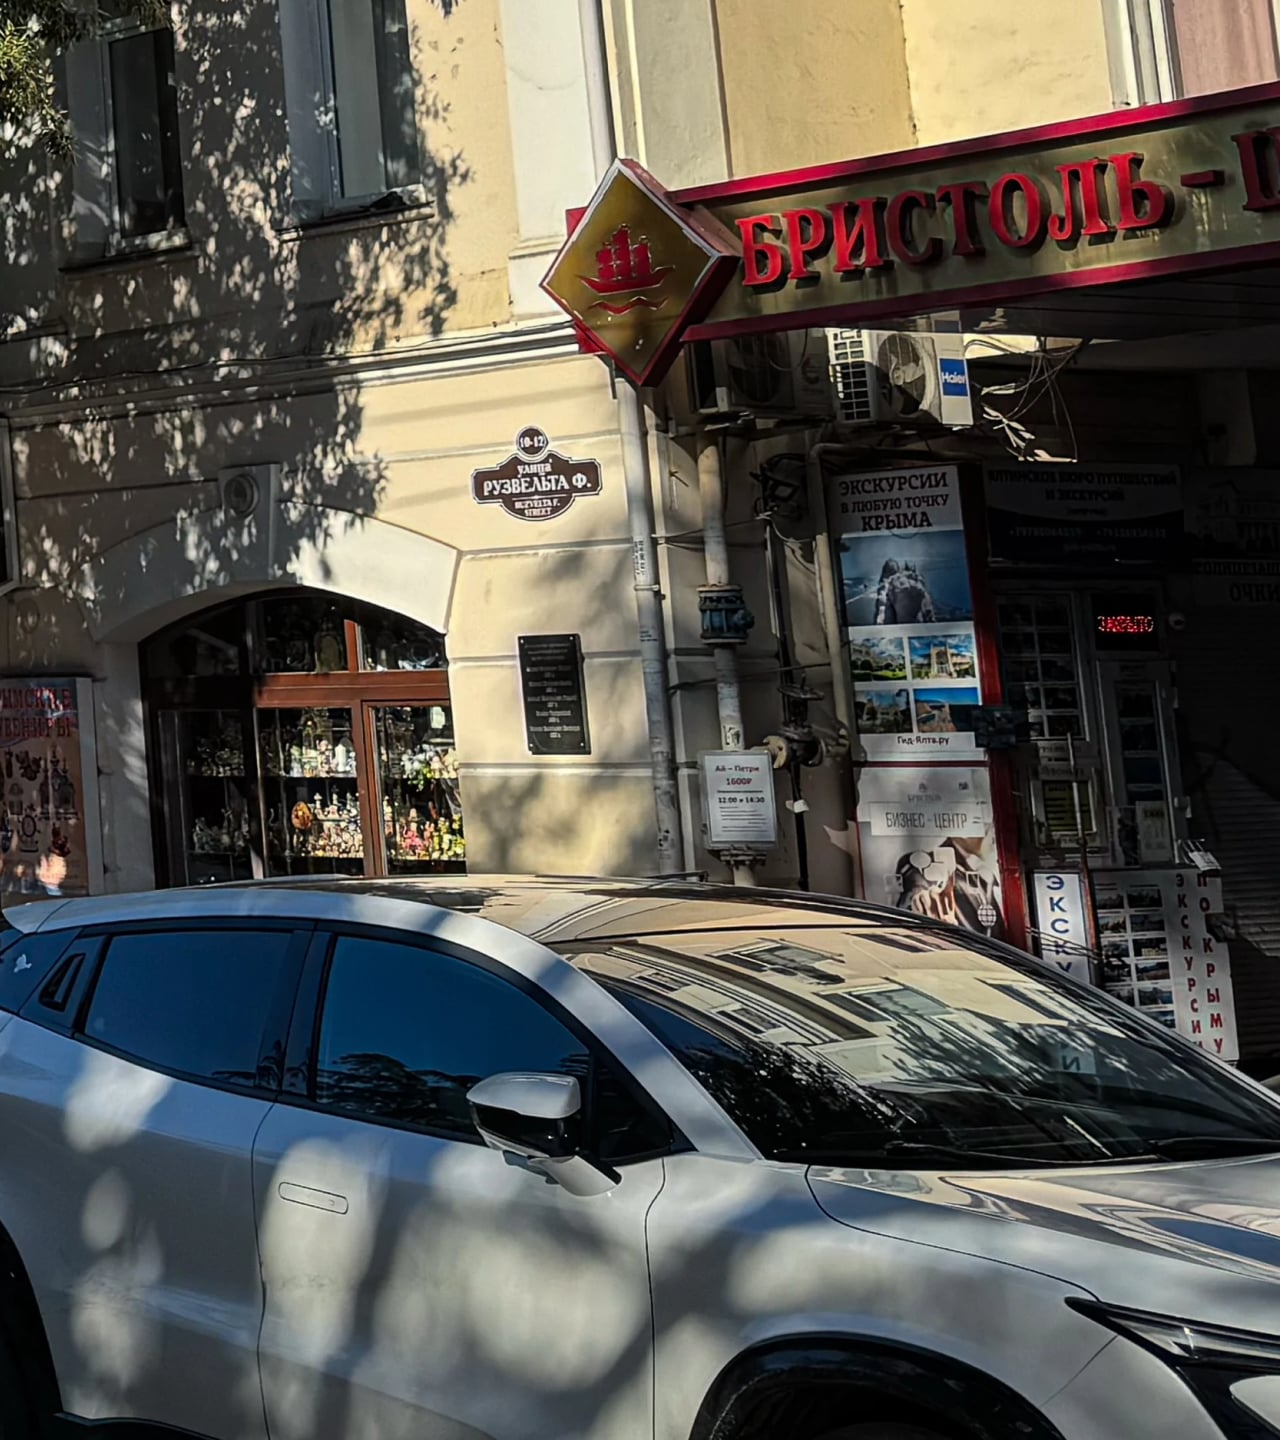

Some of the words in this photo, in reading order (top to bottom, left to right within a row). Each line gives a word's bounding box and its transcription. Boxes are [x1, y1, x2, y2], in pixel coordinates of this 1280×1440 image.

[942, 371, 966, 385] Haier
[483, 474, 569, 496] РУЗВЕЛЬТА
[571, 472, 592, 489] Ф.
[840, 471, 948, 496] ЭКСКУРСИИ
[852, 498, 902, 512] ЛЮБУЮ
[905, 494, 949, 508] ТОЧКУ
[861, 511, 932, 531] КРЫМА
[885, 811, 926, 829] БИЗНЕС
[933, 812, 968, 830] ЦЕНТР
[1202, 938, 1224, 1054] КРЫМУ
